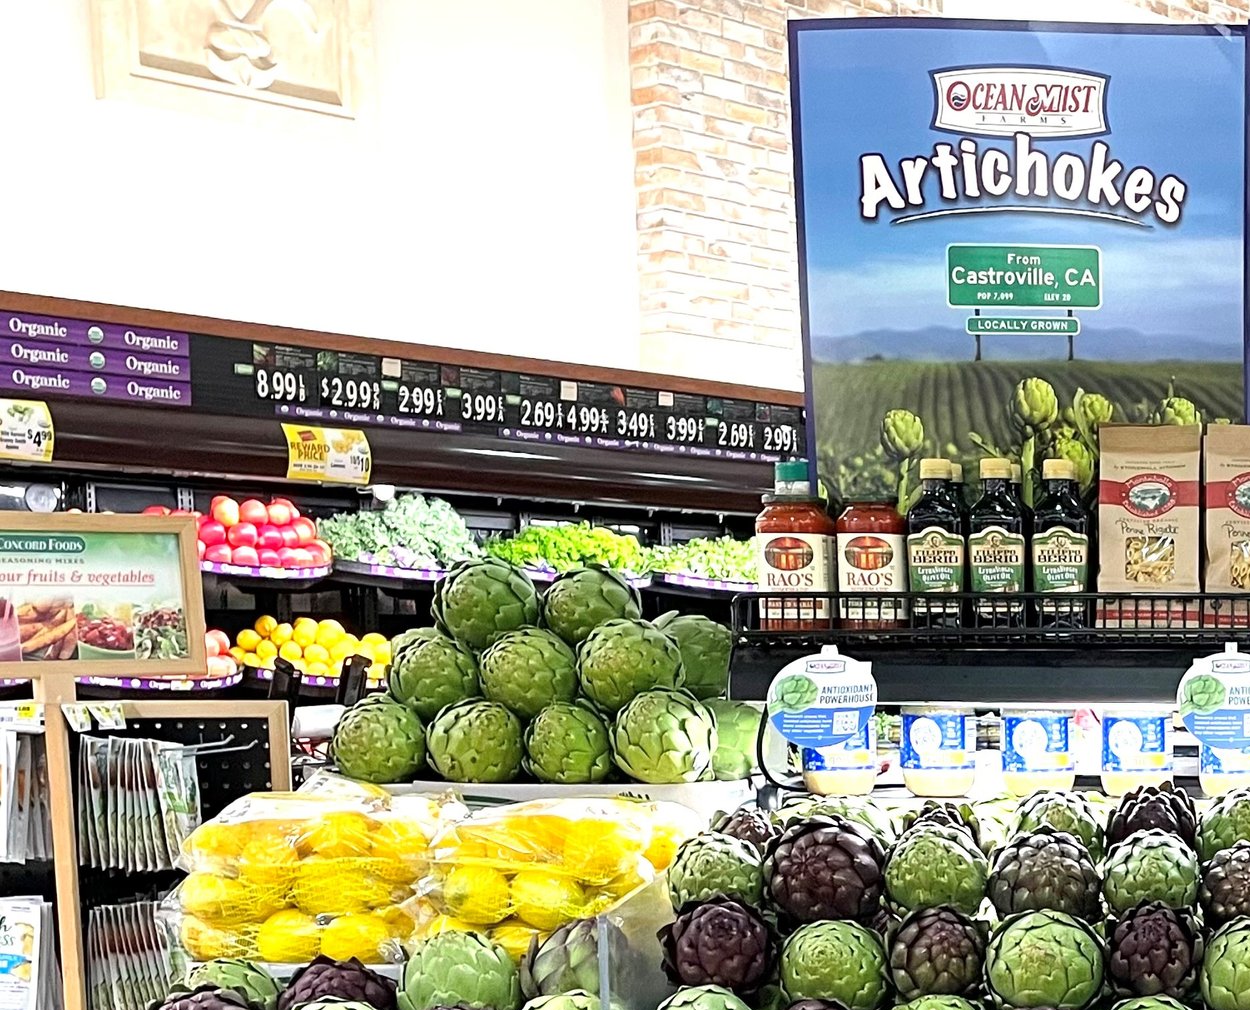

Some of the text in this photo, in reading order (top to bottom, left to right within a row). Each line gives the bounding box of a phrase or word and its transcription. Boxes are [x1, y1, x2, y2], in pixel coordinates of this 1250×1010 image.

[946, 81, 1096, 117] OCEAN MIST
[982, 115, 1066, 124] FARMS
[860, 132, 1187, 224] Artichokes
[1007, 253, 1041, 265] From
[952, 266, 1096, 288] Castroville, CA
[977, 292, 991, 300] POP
[1044, 293, 1060, 301] ELEV
[1062, 293, 1071, 301] 20
[9, 317, 179, 351] Organic Organic
[978, 320, 1068, 330] LOCALLY GROWN
[11, 343, 180, 375] Organic Organic
[12, 370, 181, 400] Organic Organic
[257, 369, 297, 400] 8.99
[321, 377, 371, 408] $2.99
[399, 386, 435, 415] 2.99
[462, 393, 496, 421] 3.99
[521, 400, 554, 427] 2.69
[567, 405, 599, 432] 4.99
[618, 410, 648, 438] 3.49
[719, 422, 748, 447] 2.69
[913, 555, 958, 563] BERIO
[973, 555, 1019, 563] BERIO
[1038, 555, 1083, 563] BERIO
[28, 569, 155, 586] fruits & vegetables
[767, 573, 813, 587] RAO'S
[847, 572, 893, 587] RAO'S
[820, 693, 873, 704] POWERHOUSE
[821, 684, 873, 694] ANTIOXIDANT
